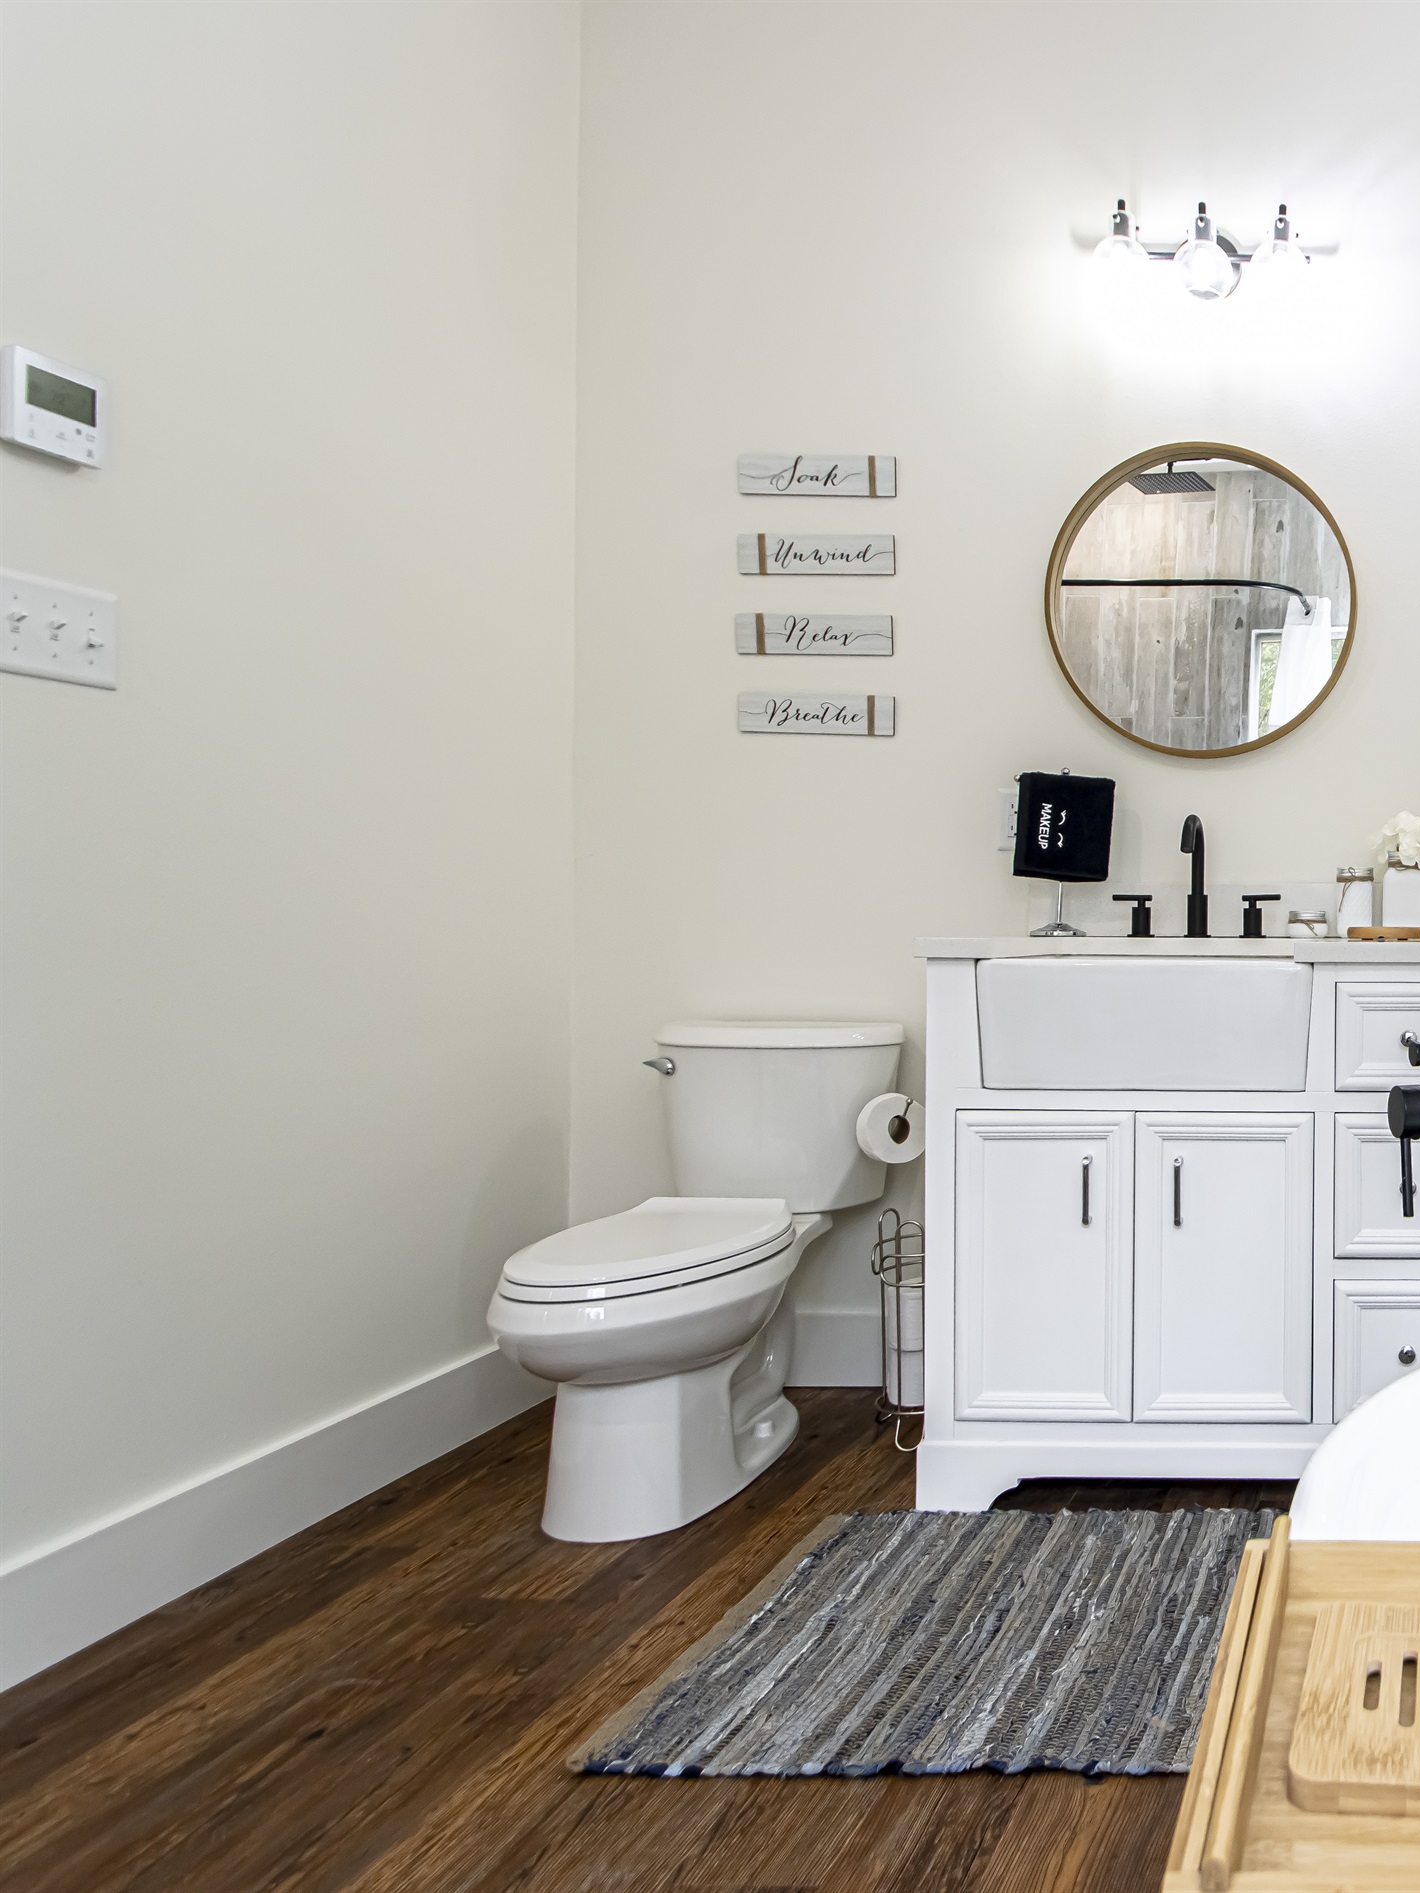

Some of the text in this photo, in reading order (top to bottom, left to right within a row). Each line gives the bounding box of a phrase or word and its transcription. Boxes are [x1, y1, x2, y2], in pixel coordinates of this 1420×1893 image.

[760, 455, 858, 492] Soak
[770, 538, 880, 570] Unwind
[778, 615, 868, 651] Relax
[760, 698, 865, 727] Breathe
[1037, 802, 1053, 850] MAKEUP
